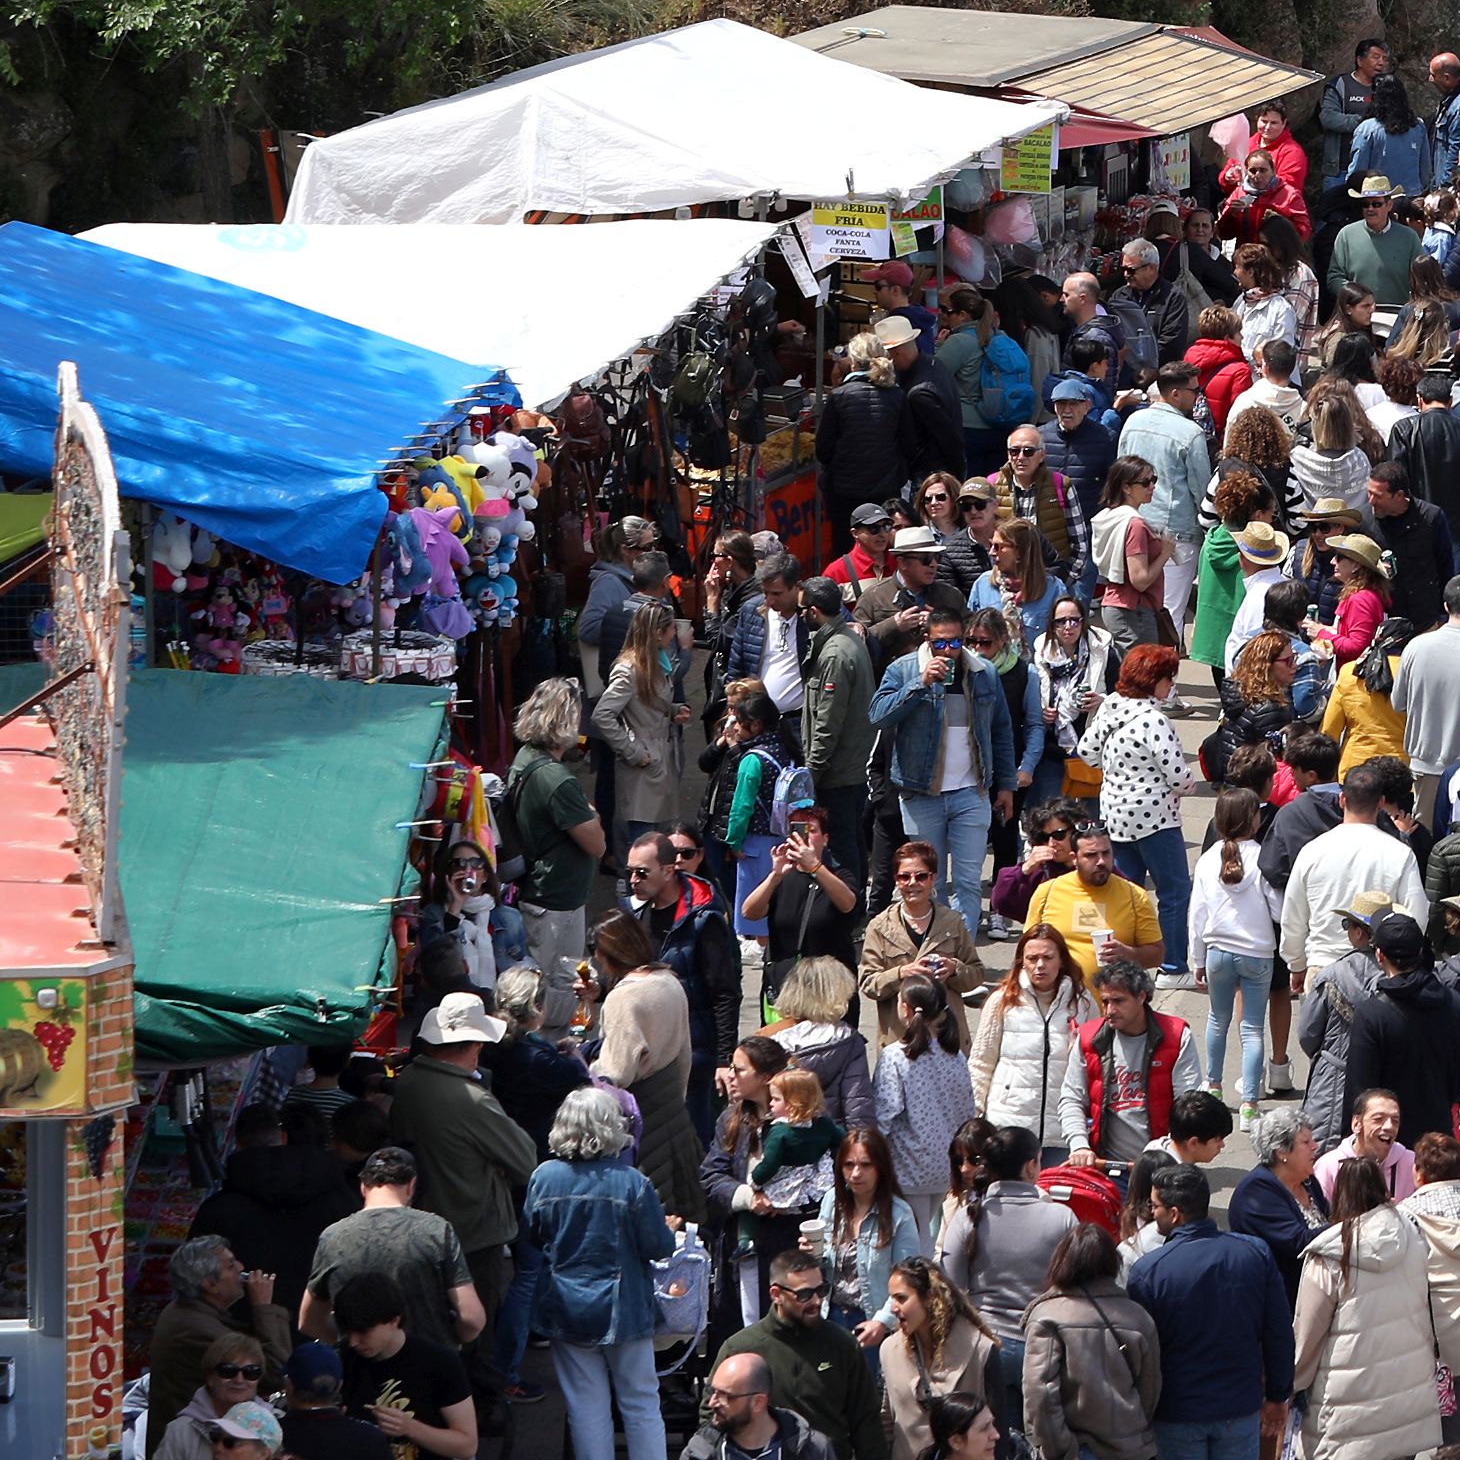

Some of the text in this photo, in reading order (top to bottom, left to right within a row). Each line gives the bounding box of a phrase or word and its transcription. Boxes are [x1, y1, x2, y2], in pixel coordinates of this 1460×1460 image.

[814, 200, 886, 214] HAY BEBIDA
[835, 214, 864, 226] FRÍA
[826, 229, 871, 238] COCA-COLA
[829, 247, 866, 255] CERVEZA
[87, 1227, 118, 1419] VINOS
